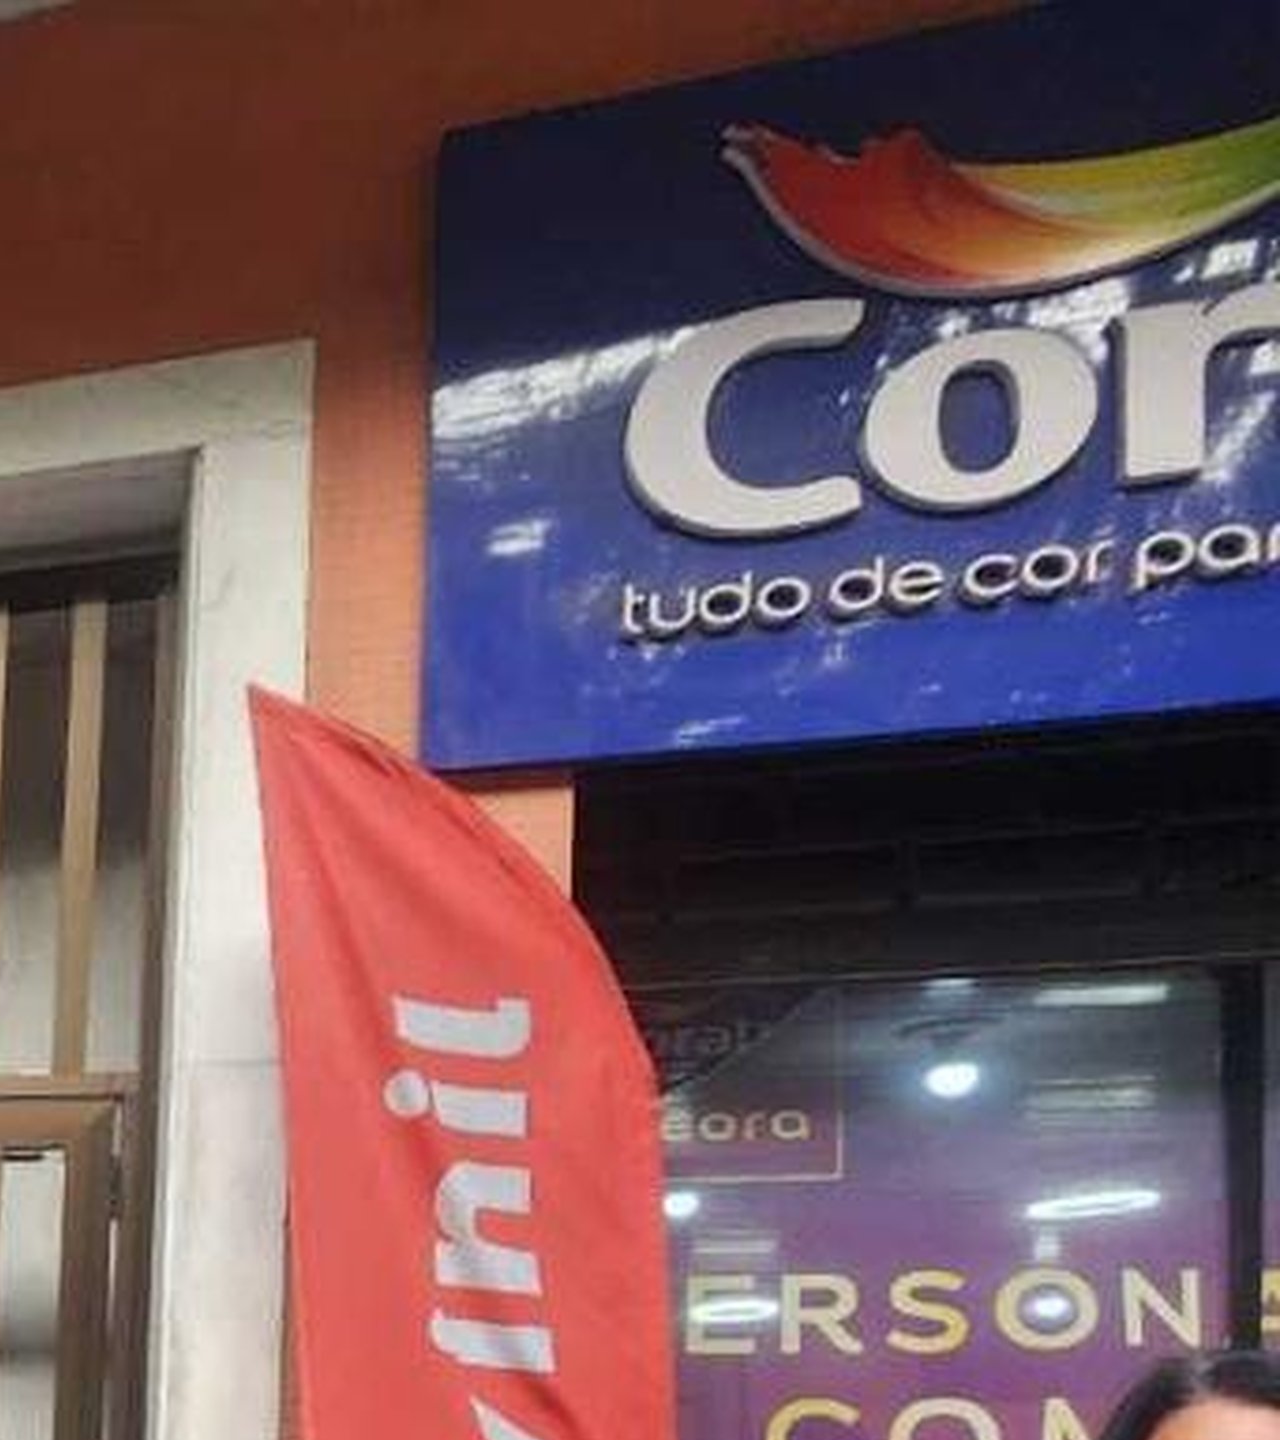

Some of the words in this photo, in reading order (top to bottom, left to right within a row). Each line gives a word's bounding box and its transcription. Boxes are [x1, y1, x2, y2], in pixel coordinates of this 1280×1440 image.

[622, 570, 811, 634] tudo
[828, 556, 942, 610] de
[963, 537, 1114, 598] cor
